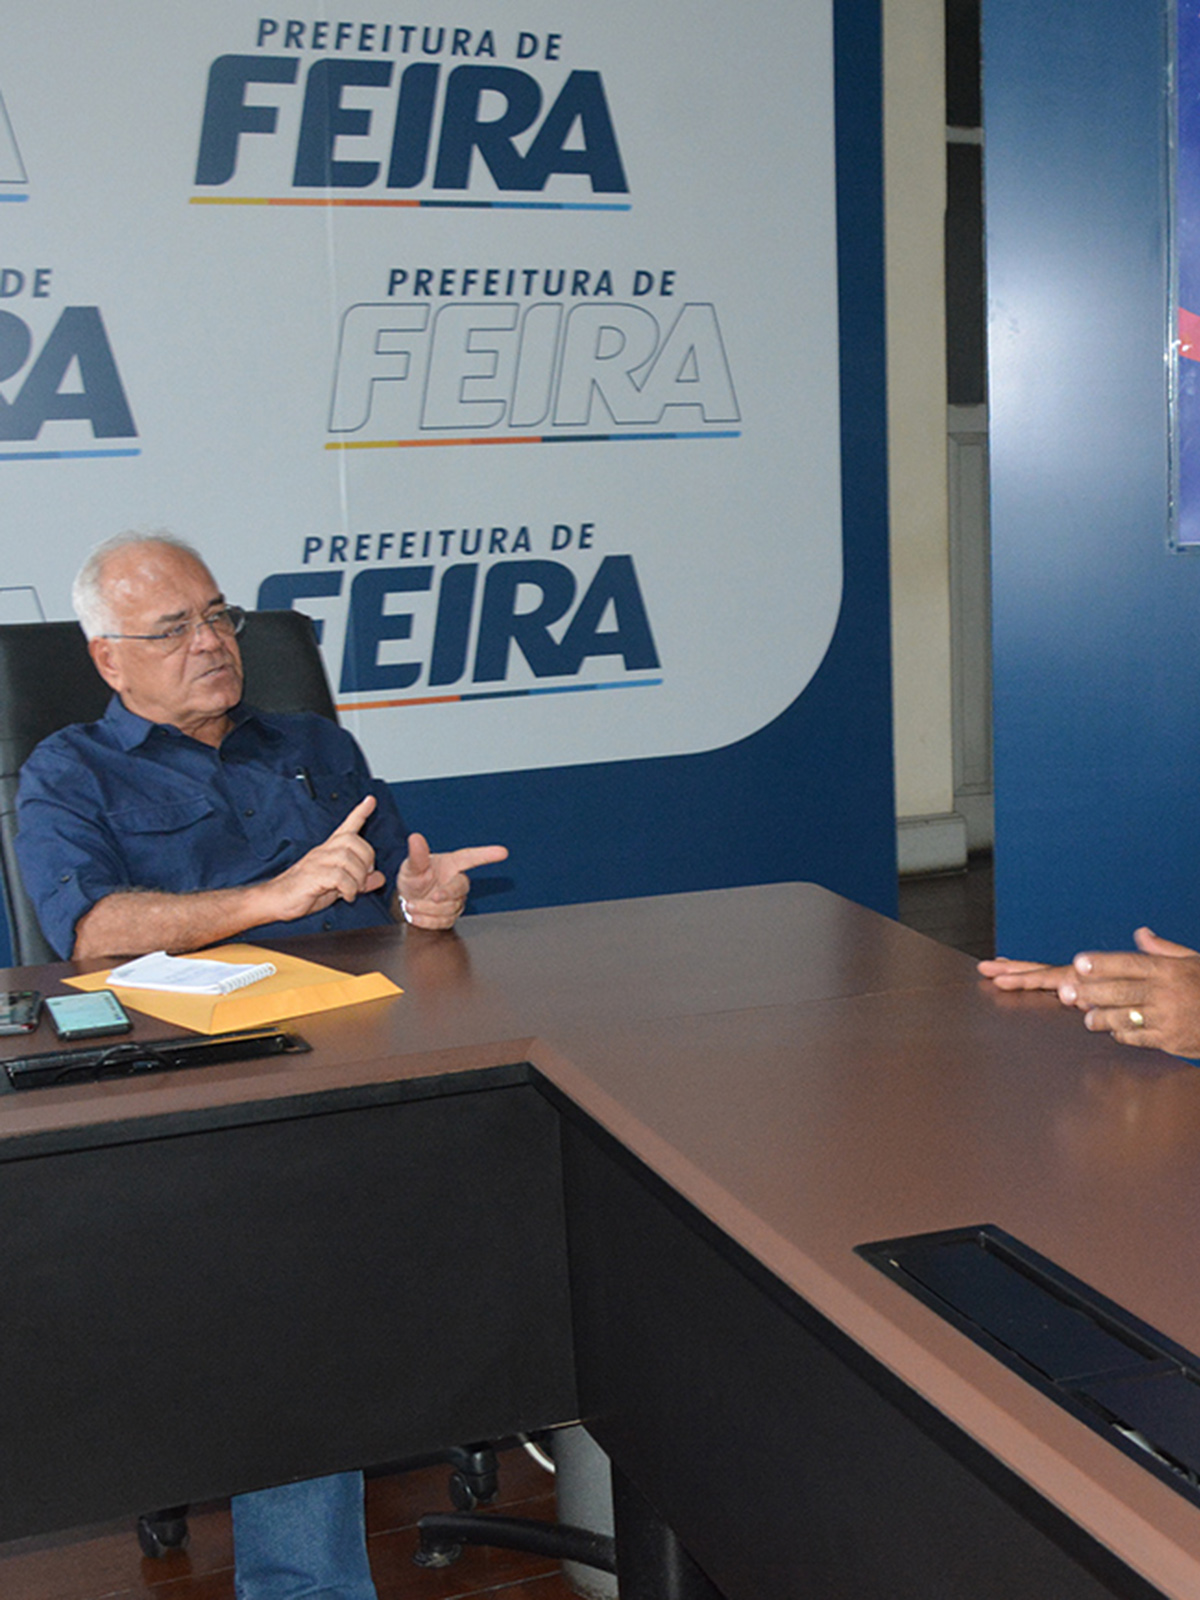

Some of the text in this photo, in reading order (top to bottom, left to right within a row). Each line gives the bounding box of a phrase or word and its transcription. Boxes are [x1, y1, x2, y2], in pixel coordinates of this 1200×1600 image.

[256, 18, 563, 61] PREFEITURA DE
[194, 53, 630, 194] FEIRA
[387, 268, 677, 297] PREFEITURA DE
[328, 303, 742, 433] FEIRA
[302, 523, 595, 564] PREFEITURA DE
